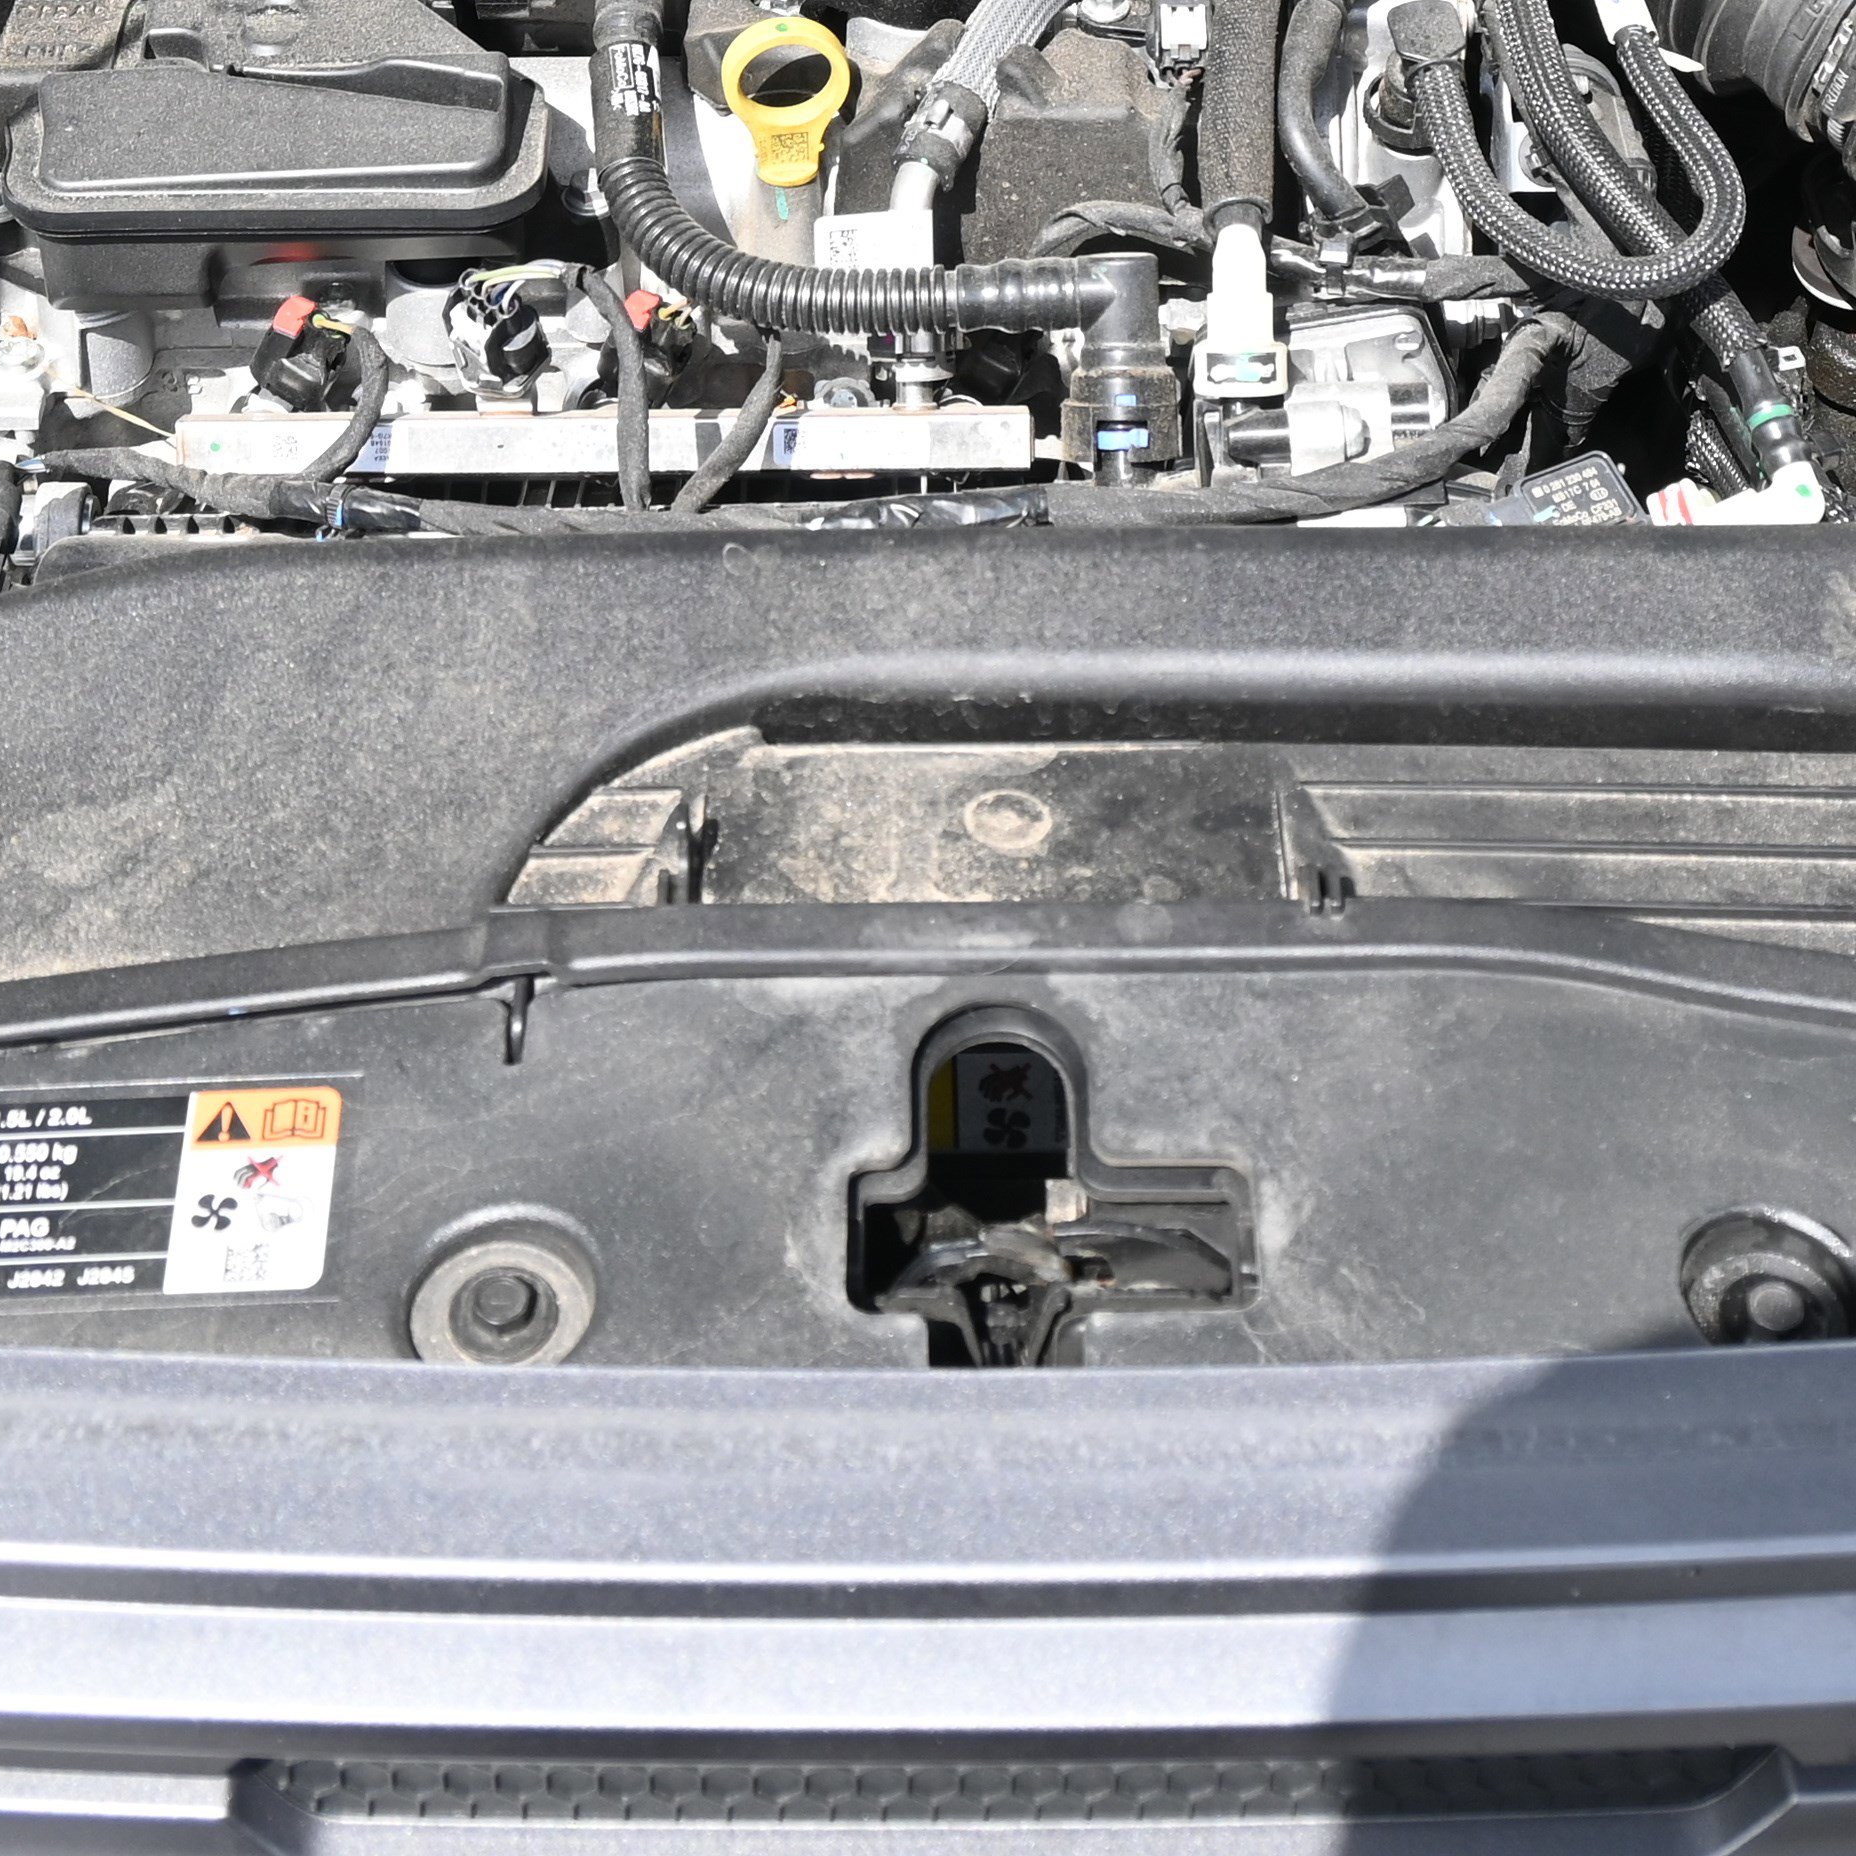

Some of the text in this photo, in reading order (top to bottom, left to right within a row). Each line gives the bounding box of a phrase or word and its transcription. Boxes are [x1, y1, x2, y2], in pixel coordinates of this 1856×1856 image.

[1823, 67, 1848, 111] TRIDON
[47, 1106, 92, 1126] 2.0L
[52, 1142, 78, 1166] kg
[36, 1181, 69, 1201] lbs)
[0, 1217, 50, 1239] PAG
